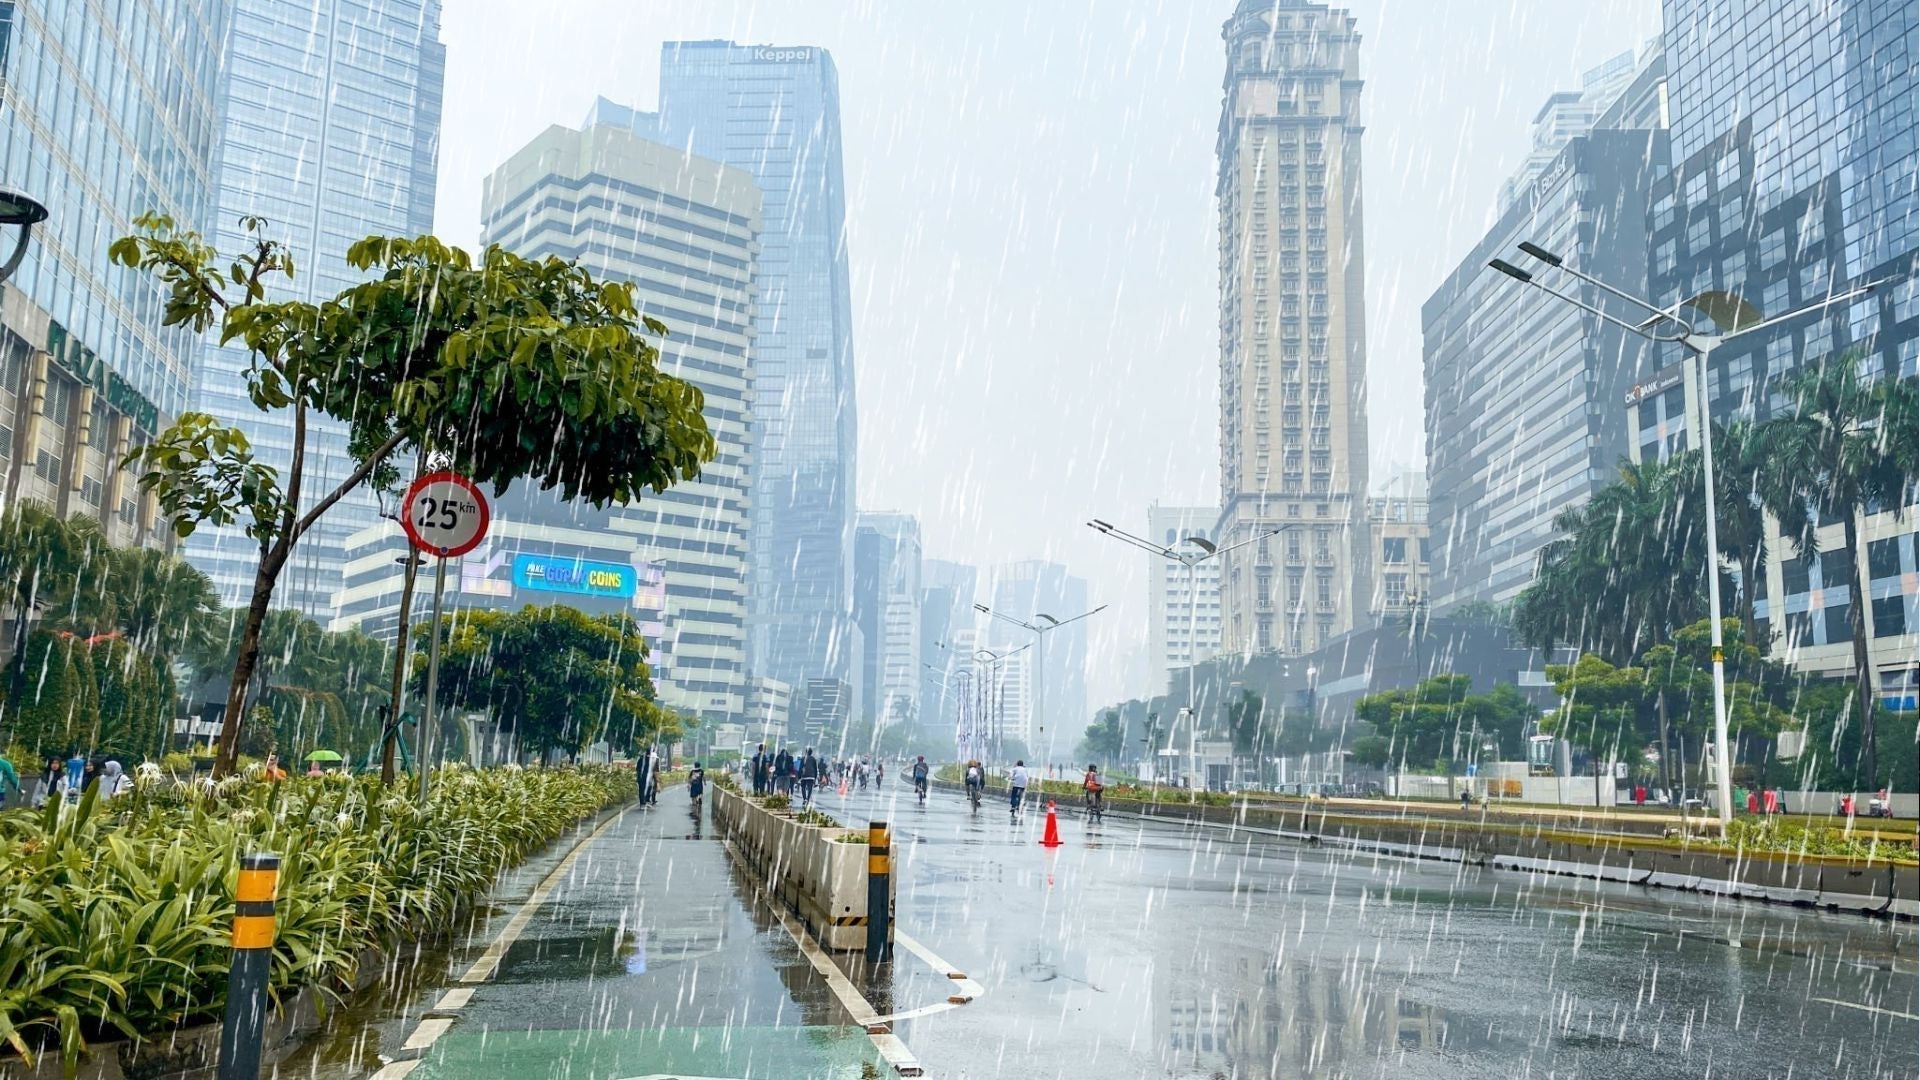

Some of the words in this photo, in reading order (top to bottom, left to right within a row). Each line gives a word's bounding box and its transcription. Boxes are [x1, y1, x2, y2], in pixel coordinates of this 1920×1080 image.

[754, 48, 810, 62] Keppel
[418, 496, 458, 530] 25
[459, 501, 476, 514] km
[589, 570, 623, 588] COINS
